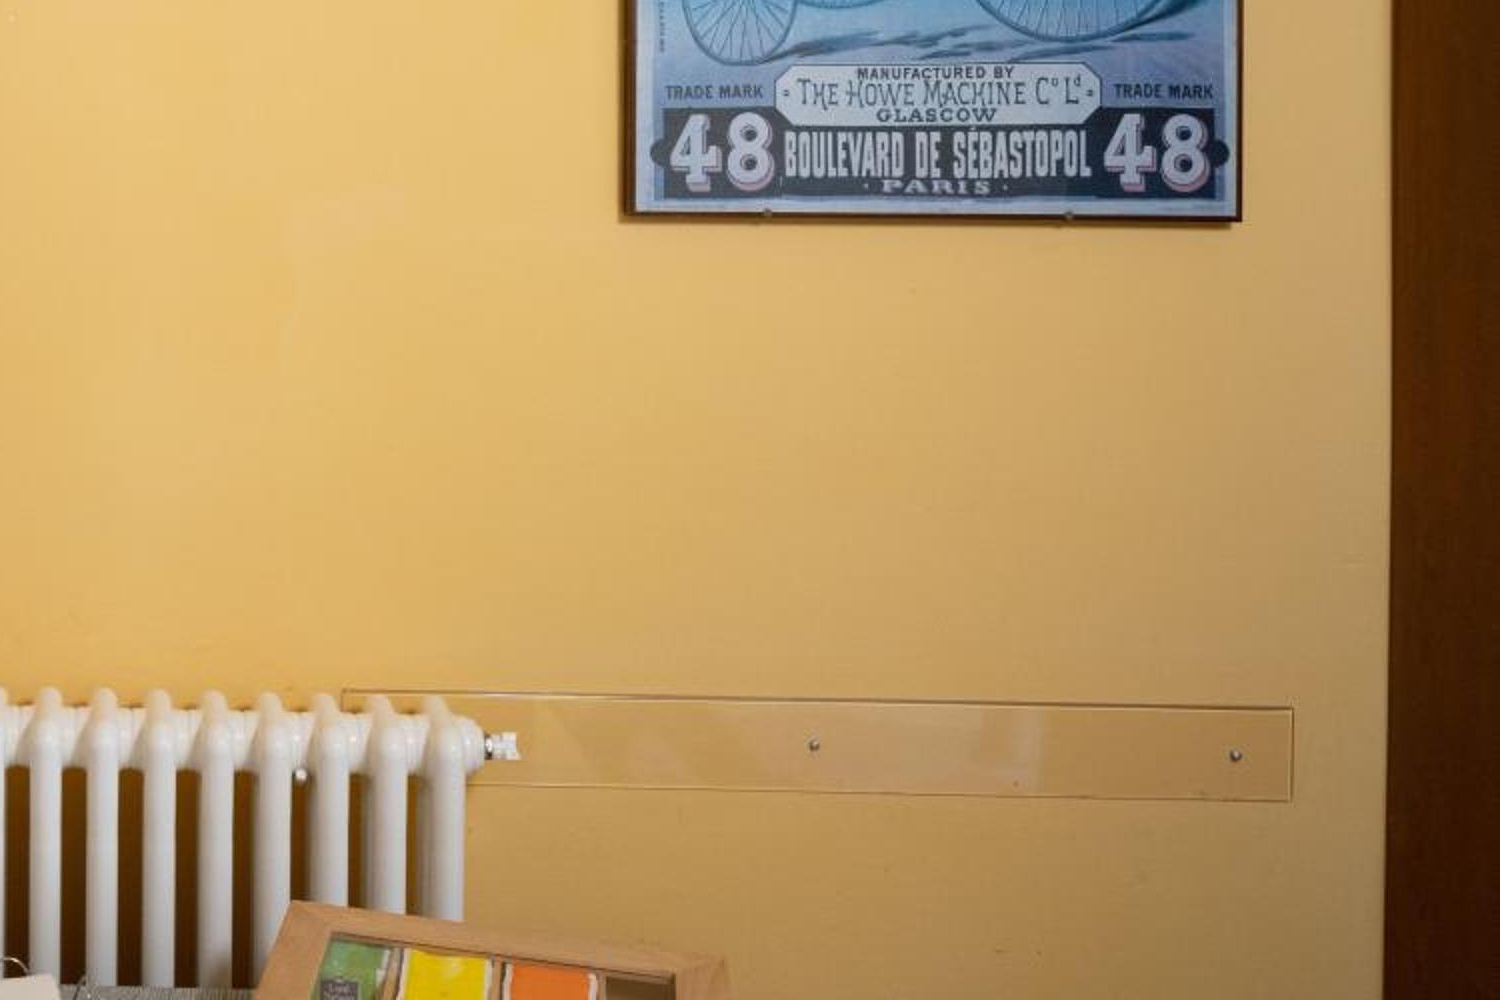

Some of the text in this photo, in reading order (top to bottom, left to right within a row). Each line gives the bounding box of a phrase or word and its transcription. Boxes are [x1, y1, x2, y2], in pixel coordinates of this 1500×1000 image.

[856, 66, 1015, 80] MANUFACTURED BY
[665, 84, 764, 100] TRADE MARK
[797, 78, 838, 110] THE
[846, 80, 915, 109] HOWE
[923, 79, 1026, 109] MACHINE
[1113, 83, 1214, 99] TRADE MARK
[668, 111, 774, 193] 48
[784, 130, 904, 179] BOULEVARD
[915, 130, 941, 179] DE
[1102, 111, 1209, 193] 48
[881, 179, 991, 195] PARIS
